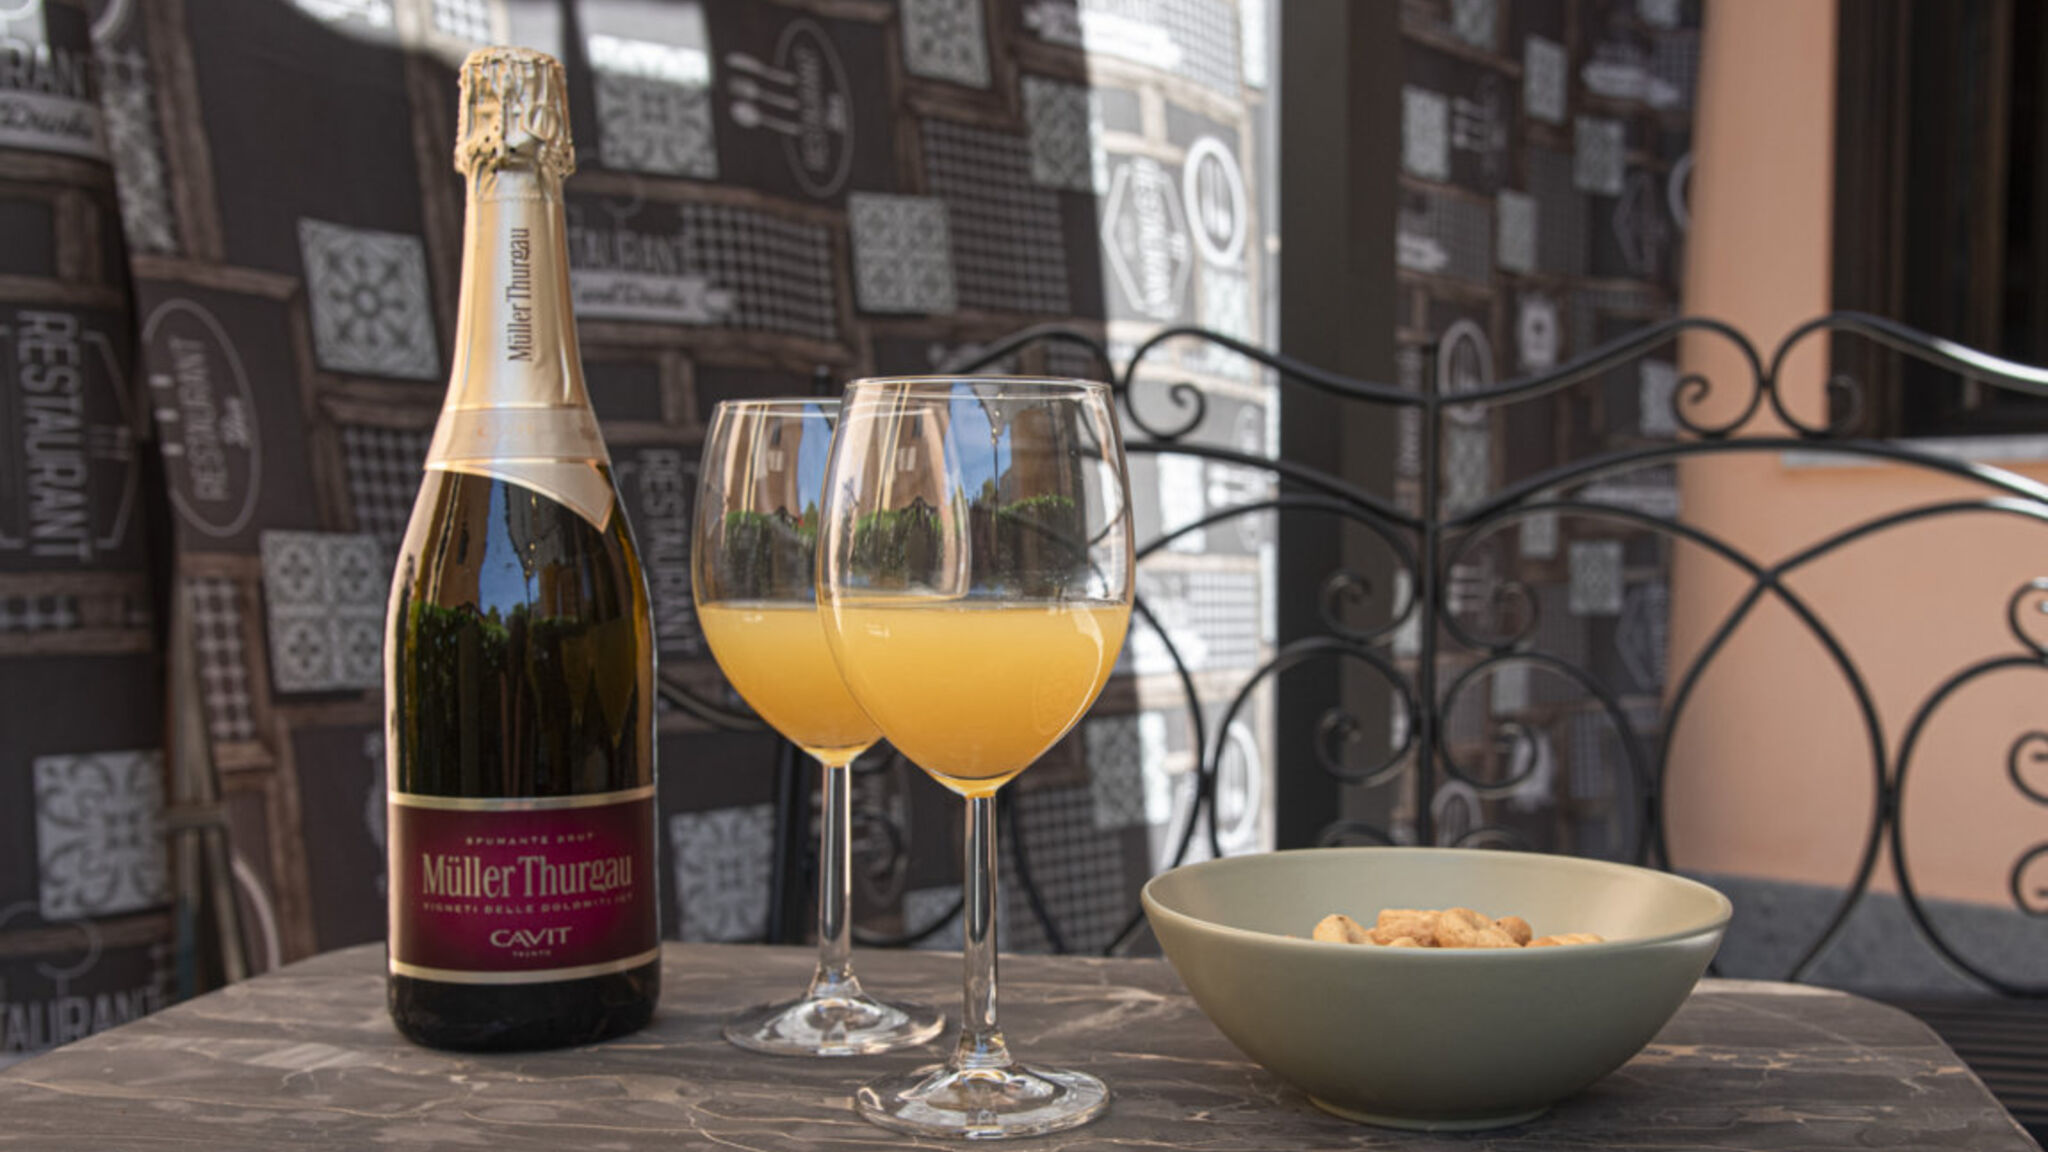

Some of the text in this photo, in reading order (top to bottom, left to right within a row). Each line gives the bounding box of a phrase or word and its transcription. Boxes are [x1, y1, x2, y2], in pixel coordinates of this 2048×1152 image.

[16, 310, 92, 561] RESTAURANT
[168, 336, 230, 501] RESTAURANT
[640, 450, 699, 656] RESTAURANT
[466, 832, 594, 846] SPUMANTE BRUT
[484, 903, 533, 914] DELLE
[490, 926, 573, 947] CAVIT
